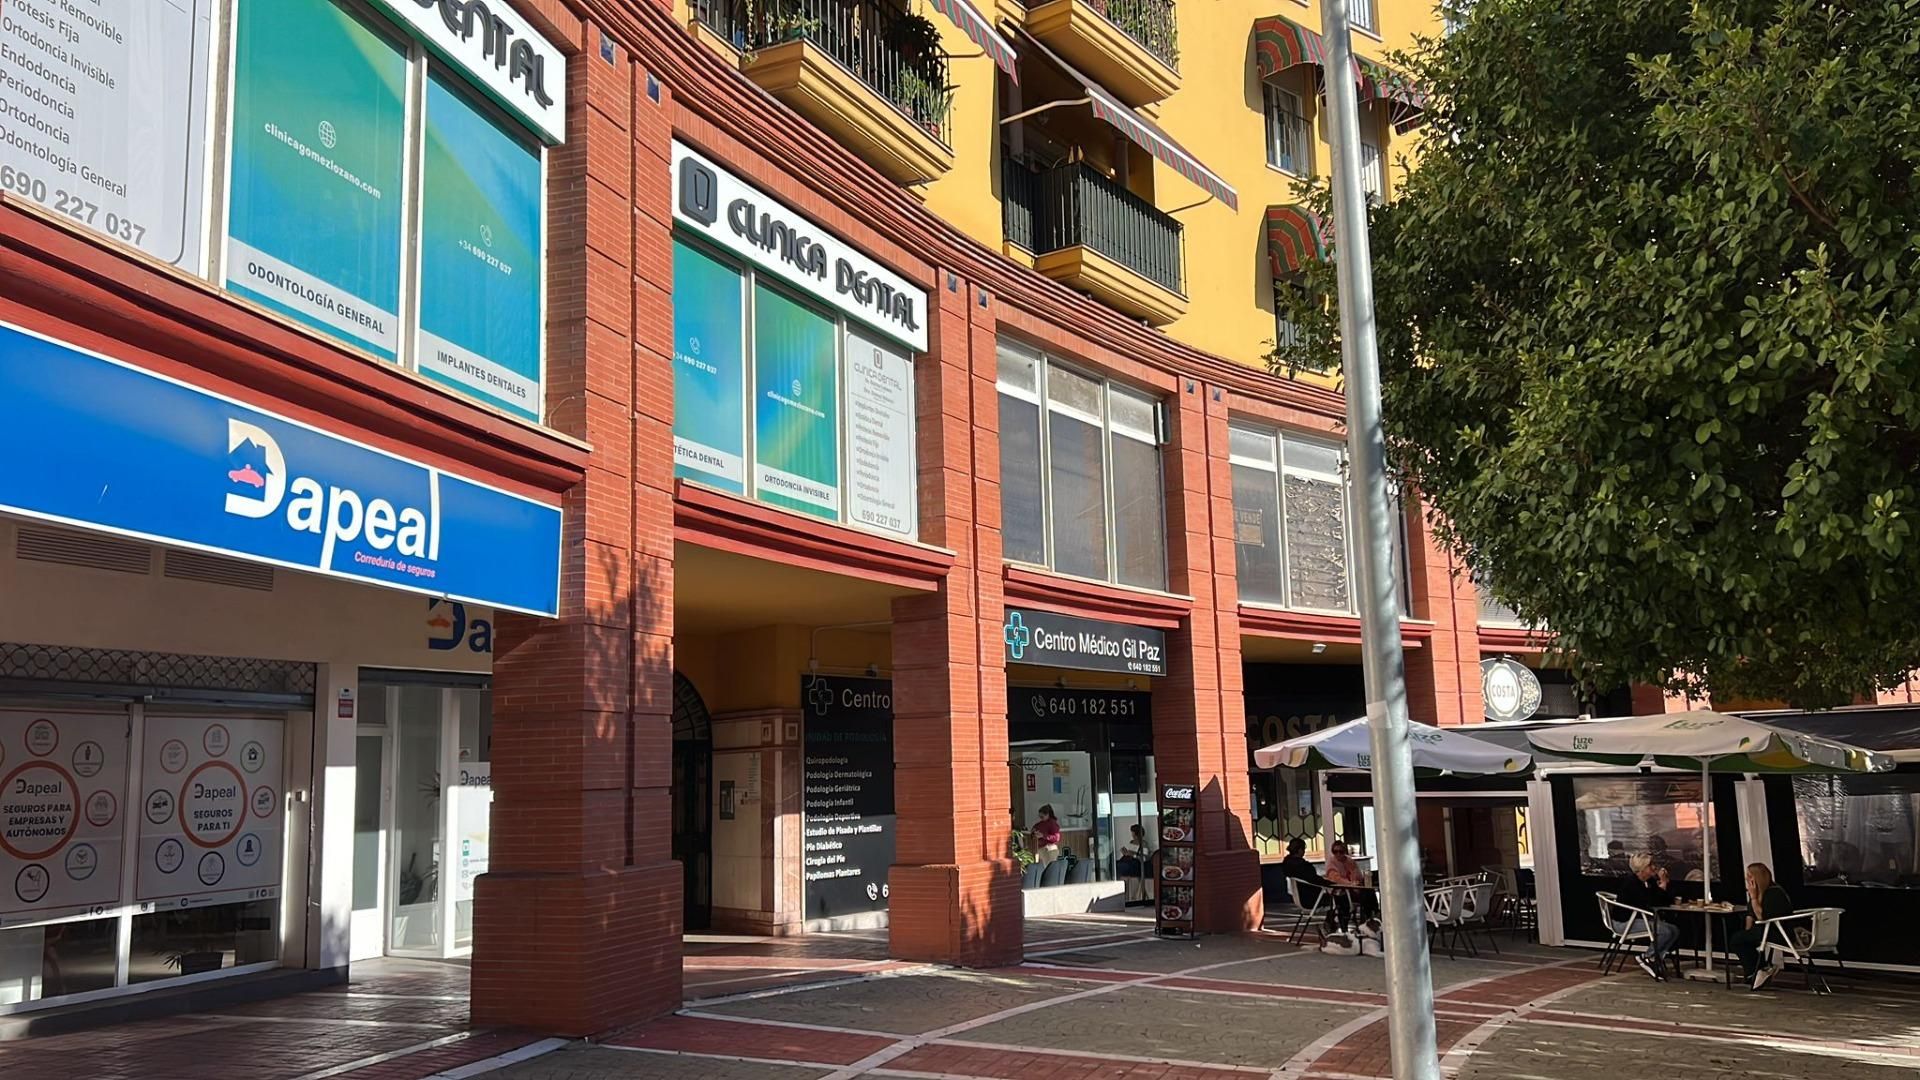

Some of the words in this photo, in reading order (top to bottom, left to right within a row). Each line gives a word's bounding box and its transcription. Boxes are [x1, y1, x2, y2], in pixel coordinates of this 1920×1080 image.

[58, 20, 80, 43] Fija
[60, 0, 122, 44] Removible
[3, 16, 67, 62] Ortodoncia
[70, 53, 115, 89] Invisible
[1, 43, 76, 94] Endodoncia
[0, 69, 74, 119] Periodoncia
[0, 97, 70, 144] Ortodoncia
[264, 122, 381, 199] clinicagomezlozano.com
[81, 166, 127, 198] General
[0, 165, 46, 203] 690
[54, 189, 98, 224] 227
[105, 212, 146, 246] 037
[472, 246, 486, 261] 690
[486, 253, 500, 268] 227
[500, 261, 512, 276] 037
[728, 198, 827, 281] CLINICA
[836, 258, 919, 332] DENTAL
[248, 262, 334, 312] ODONTOLOGÍA
[337, 303, 385, 334] GENERAL
[437, 350, 486, 381] IMPLANTES
[488, 372, 526, 398] DENTALES
[698, 452, 724, 468] DENTAL
[225, 418, 440, 571] Dapeal
[764, 473, 802, 492] ORTODONCIA
[802, 485, 830, 500] INVISIBLE
[396, 560, 406, 572] de
[407, 565, 436, 578] seguros
[1034, 627, 1076, 652] Centro
[1078, 632, 1120, 657] Médico
[1122, 638, 1137, 659] Gil
[1140, 641, 1160, 661] Paz
[1132, 662, 1142, 671] 640
[1142, 664, 1152, 672] 182
[1152, 664, 1160, 672] 551
[842, 688, 890, 709] Centro
[1492, 685, 1516, 698] COSTA
[1050, 698, 1076, 714] 640
[1082, 699, 1106, 715] 182
[1111, 700, 1135, 716] 551
[1574, 736, 1593, 744] fuze
[16, 779, 62, 797] Dapeal
[194, 783, 236, 801] Dapeal
[4, 804, 46, 814] SEGUROS
[47, 803, 72, 813] PARA
[194, 808, 232, 819] SEGUROS
[9, 816, 58, 826] EMPRESAS
[58, 816, 64, 824] Y
[197, 822, 222, 832] PARA
[222, 822, 230, 830] TI
[806, 828, 828, 837] Estudio
[828, 827, 836, 835] de
[836, 826, 854, 835] Pisada
[858, 824, 882, 833] Plantillas
[6, 826, 66, 838] AUTÓNOMOS
[806, 843, 816, 852] Pie
[816, 842, 842, 850] Diabético
[806, 857, 826, 866] Cirugía
[826, 856, 836, 864] del
[806, 871, 835, 881] Papilomas
[836, 868, 862, 878] Plantares
